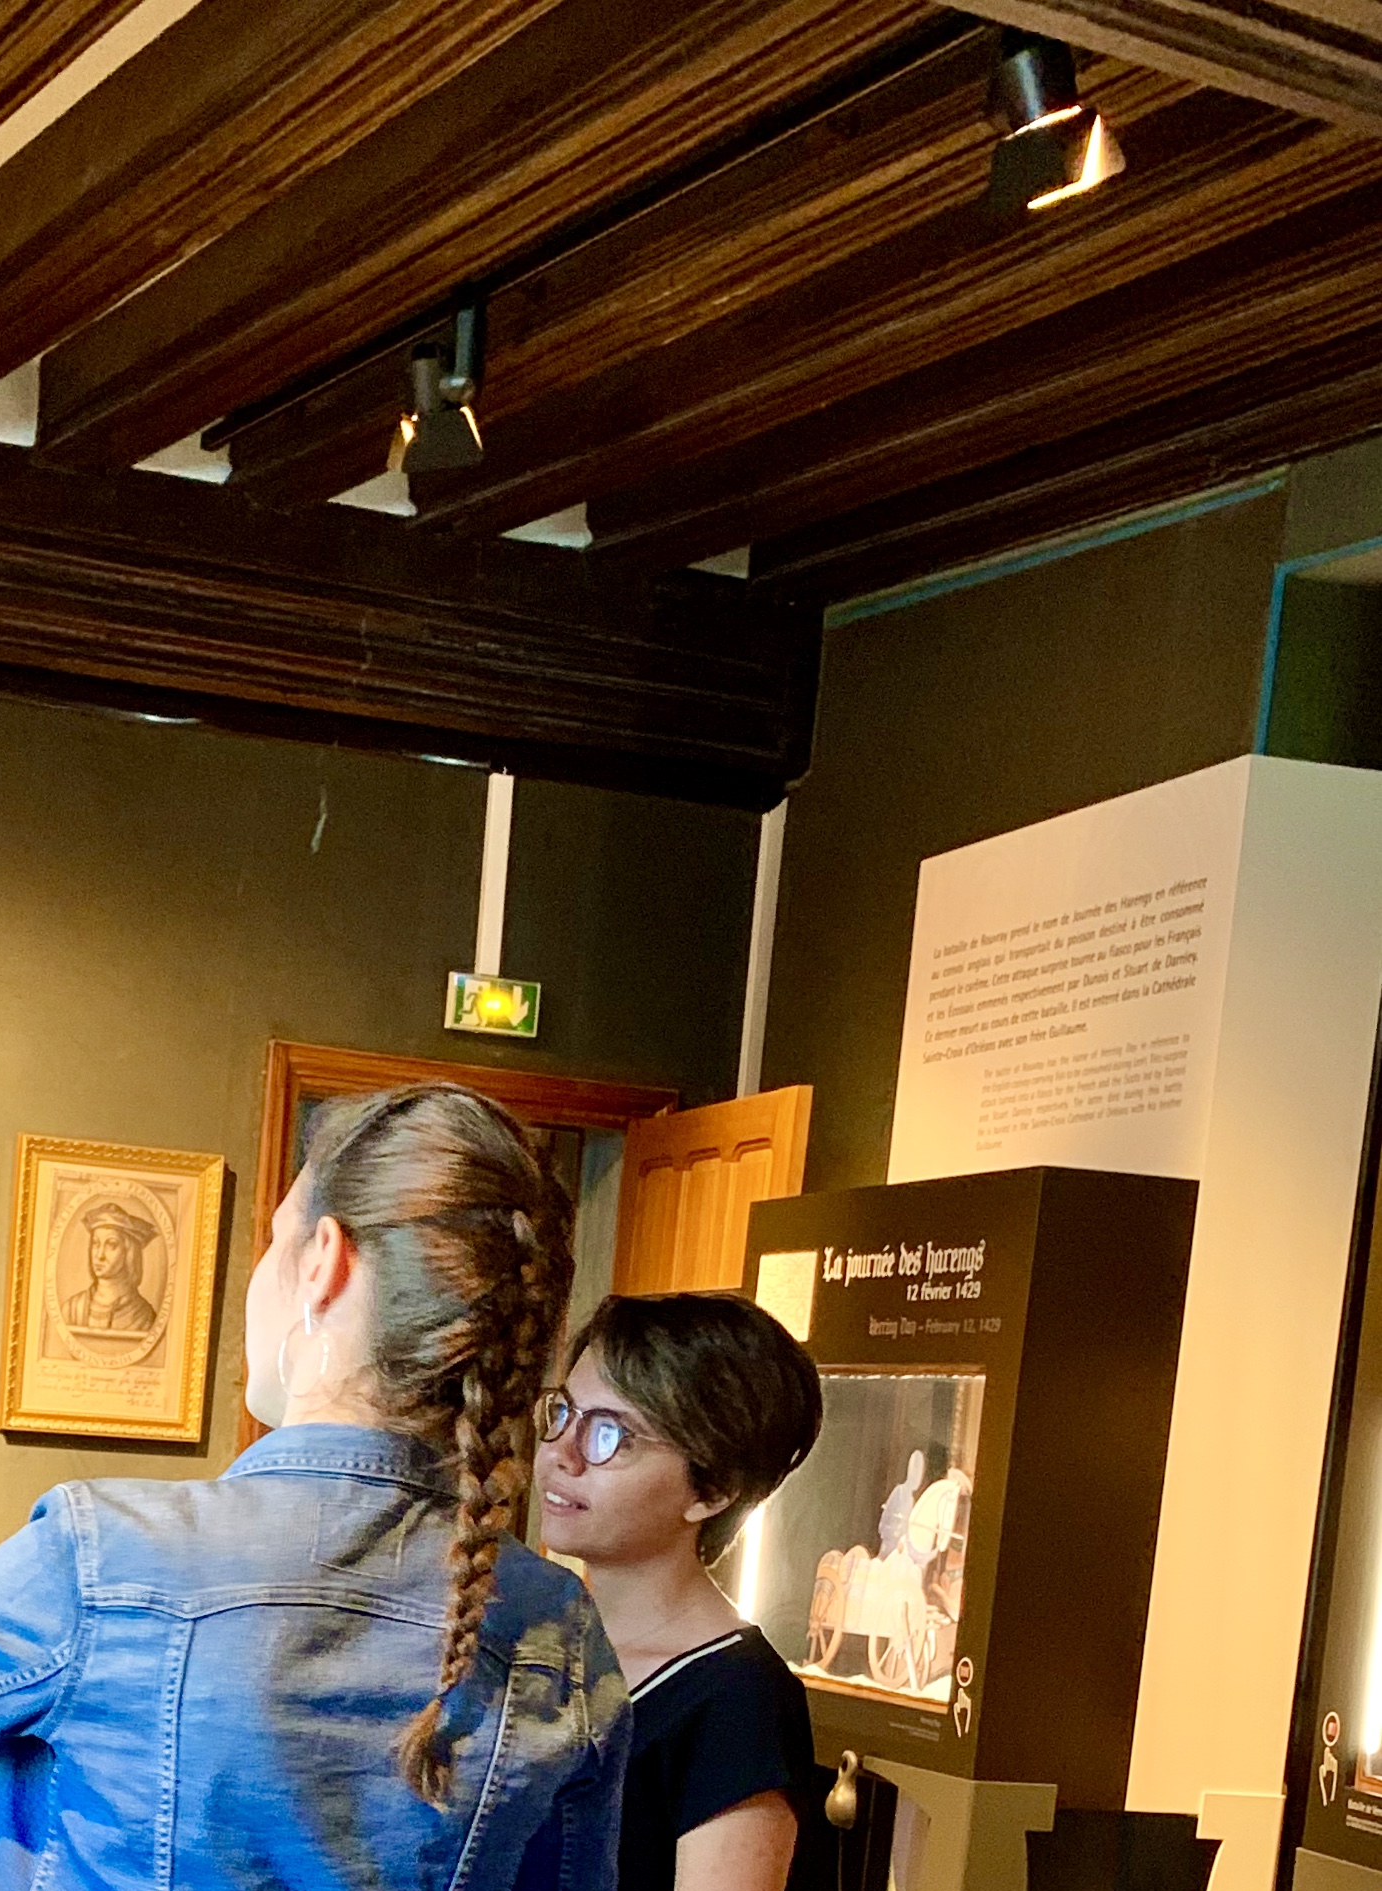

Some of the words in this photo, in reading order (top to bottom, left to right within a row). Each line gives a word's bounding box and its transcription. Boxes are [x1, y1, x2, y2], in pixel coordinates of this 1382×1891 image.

[822, 1246, 843, 1283] La
[844, 1244, 895, 1287] journée
[898, 1241, 924, 1277] des
[925, 1238, 986, 1280] harengs
[906, 1283, 918, 1301] 12
[920, 1281, 953, 1300] février
[955, 1280, 982, 1299] 1429
